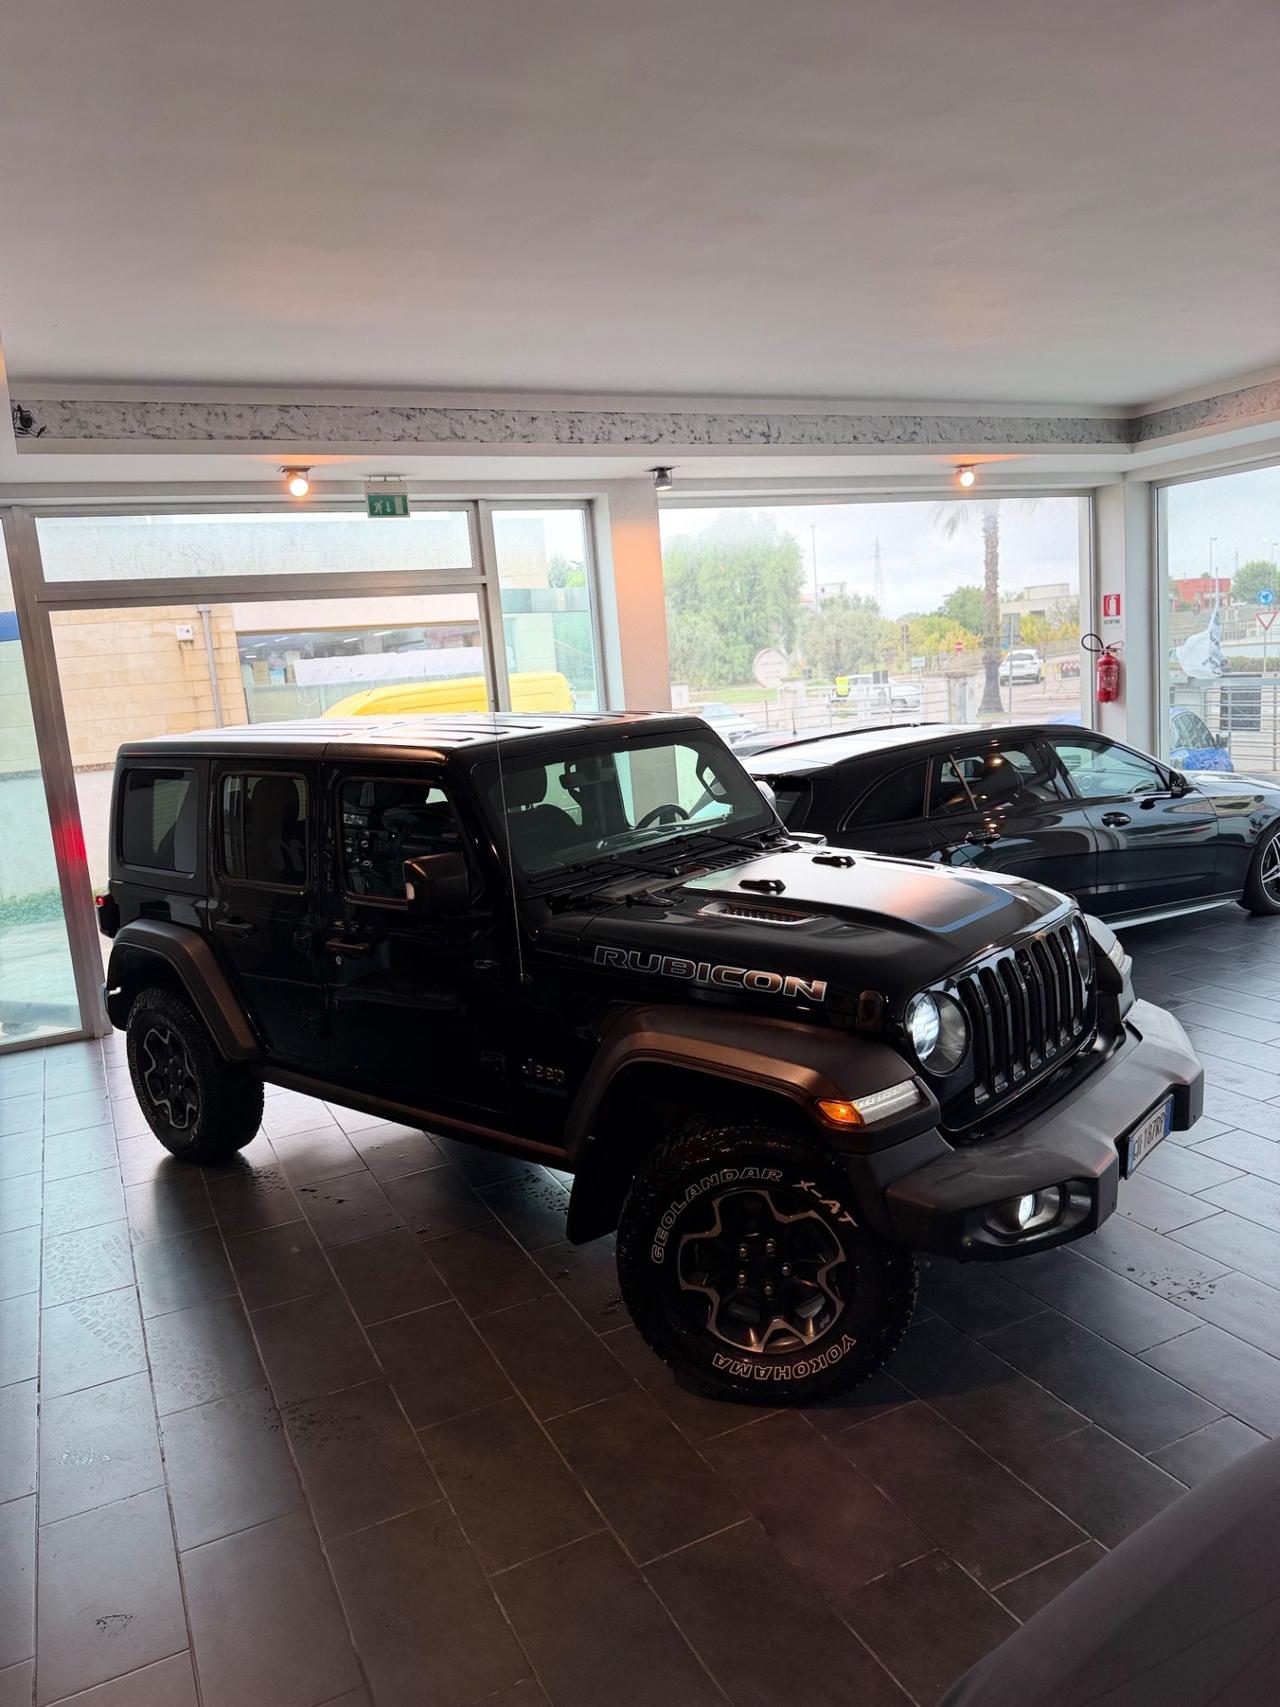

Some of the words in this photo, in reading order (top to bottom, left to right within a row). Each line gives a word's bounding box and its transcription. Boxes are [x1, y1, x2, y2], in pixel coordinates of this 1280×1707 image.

[594, 945, 828, 1002] RUBICON
[651, 1167, 784, 1264] GEOLANDAR
[792, 1179, 859, 1228] X-AT
[712, 1334, 857, 1381] YOKOHAMA
